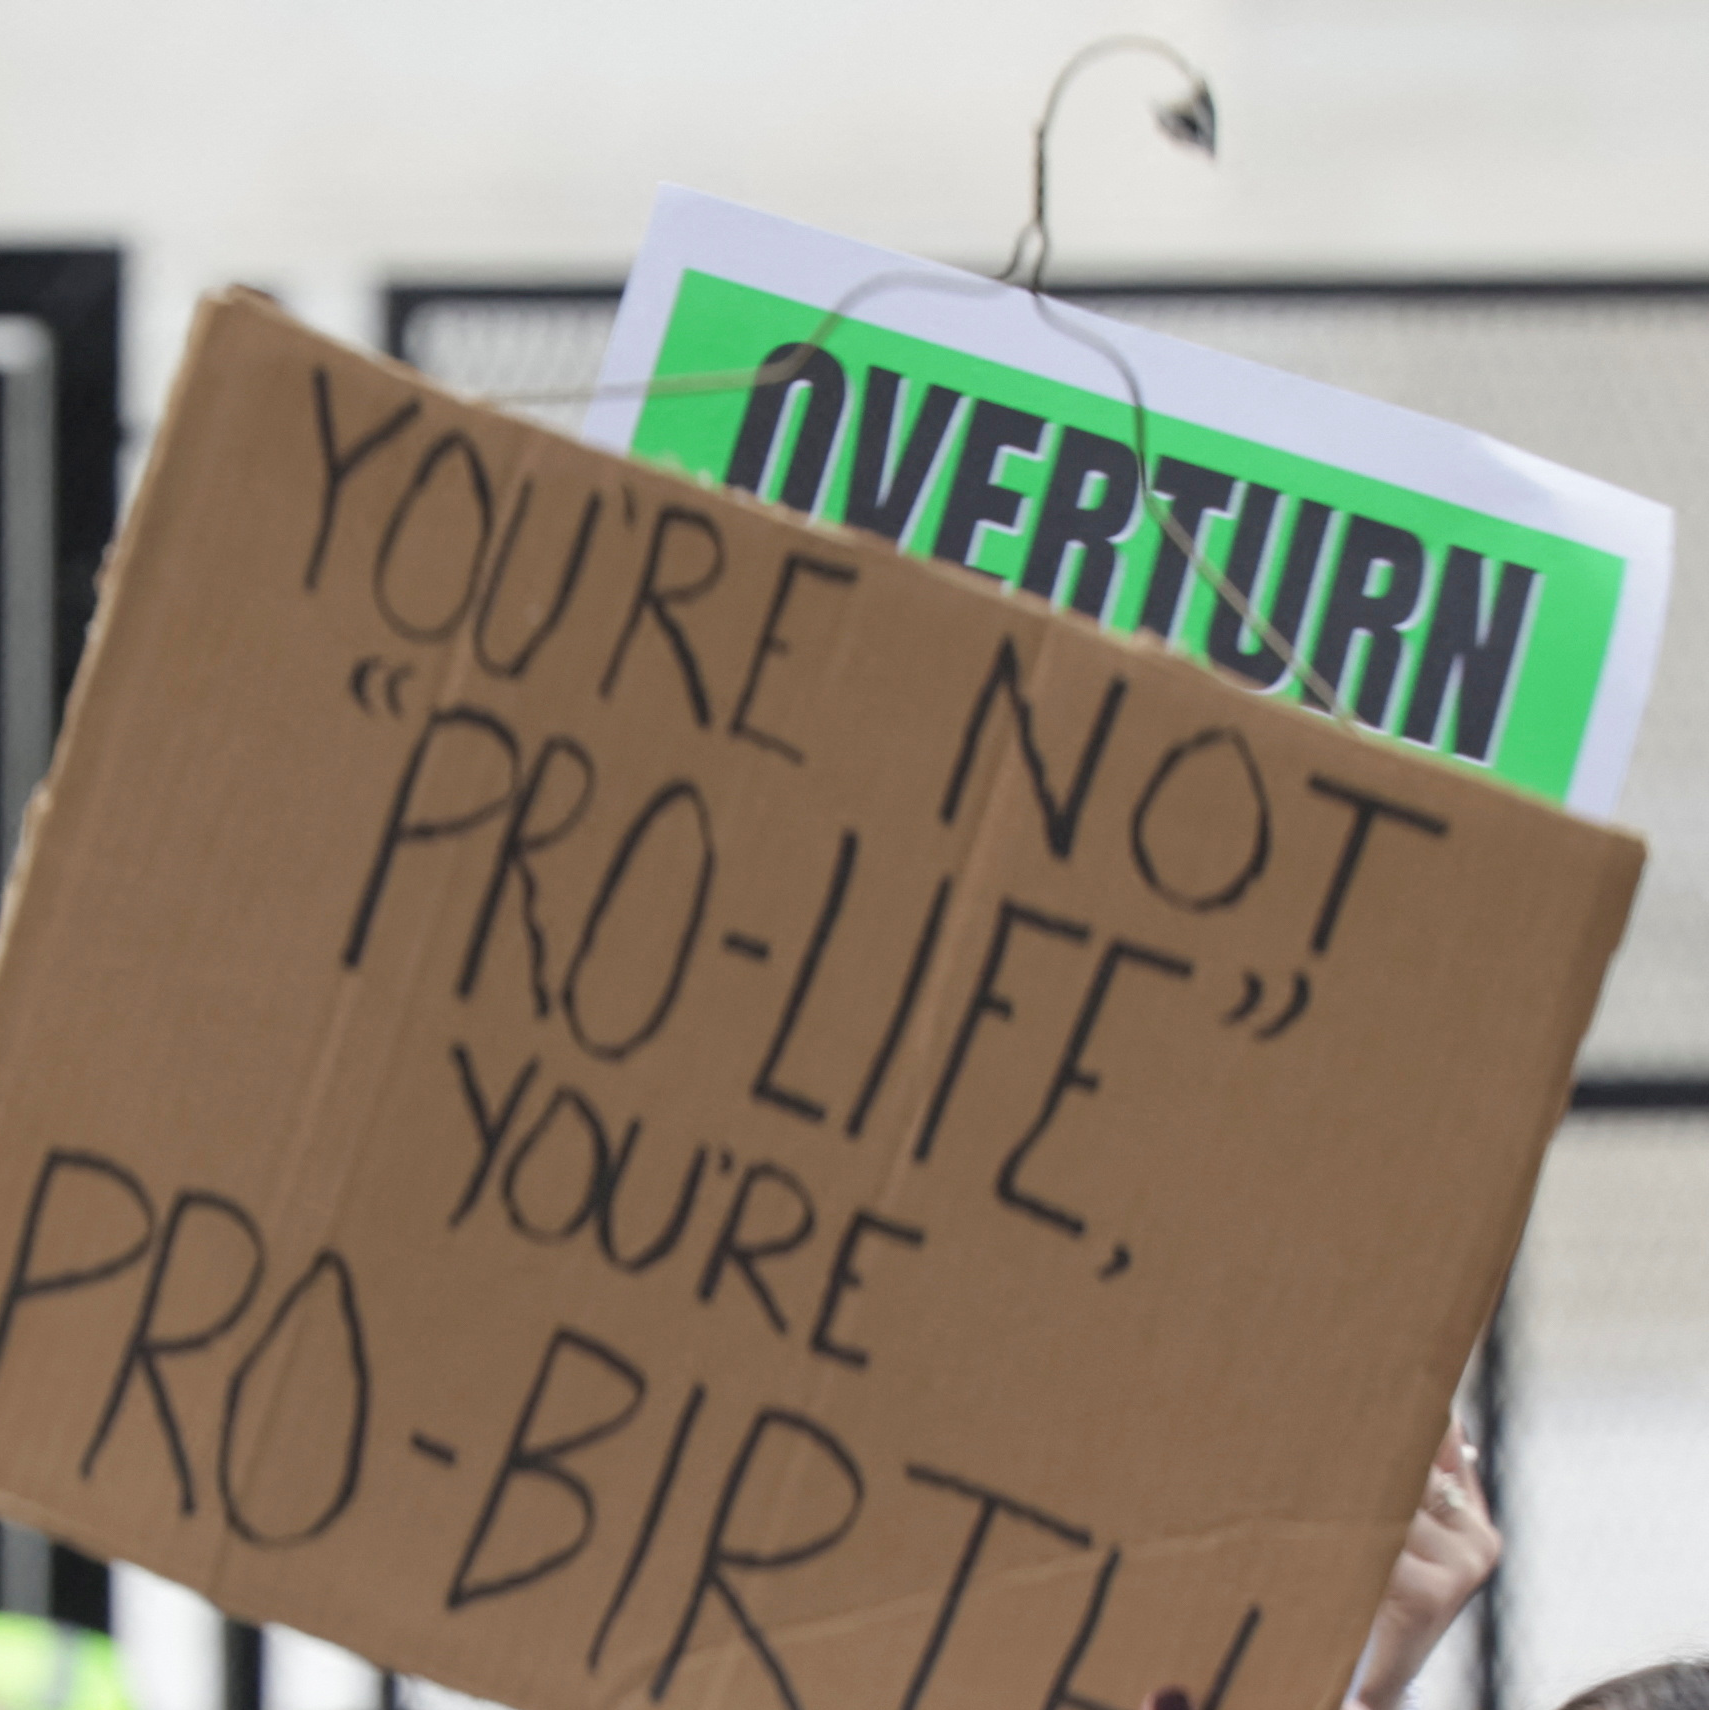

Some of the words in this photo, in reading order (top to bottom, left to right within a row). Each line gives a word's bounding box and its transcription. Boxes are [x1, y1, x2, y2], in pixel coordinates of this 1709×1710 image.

[306, 365, 859, 763] YOU'RE
[941, 635, 1451, 955] NOT
[725, 340, 1545, 766] OVERTURN
[449, 1040, 927, 1368] YOU'RE
